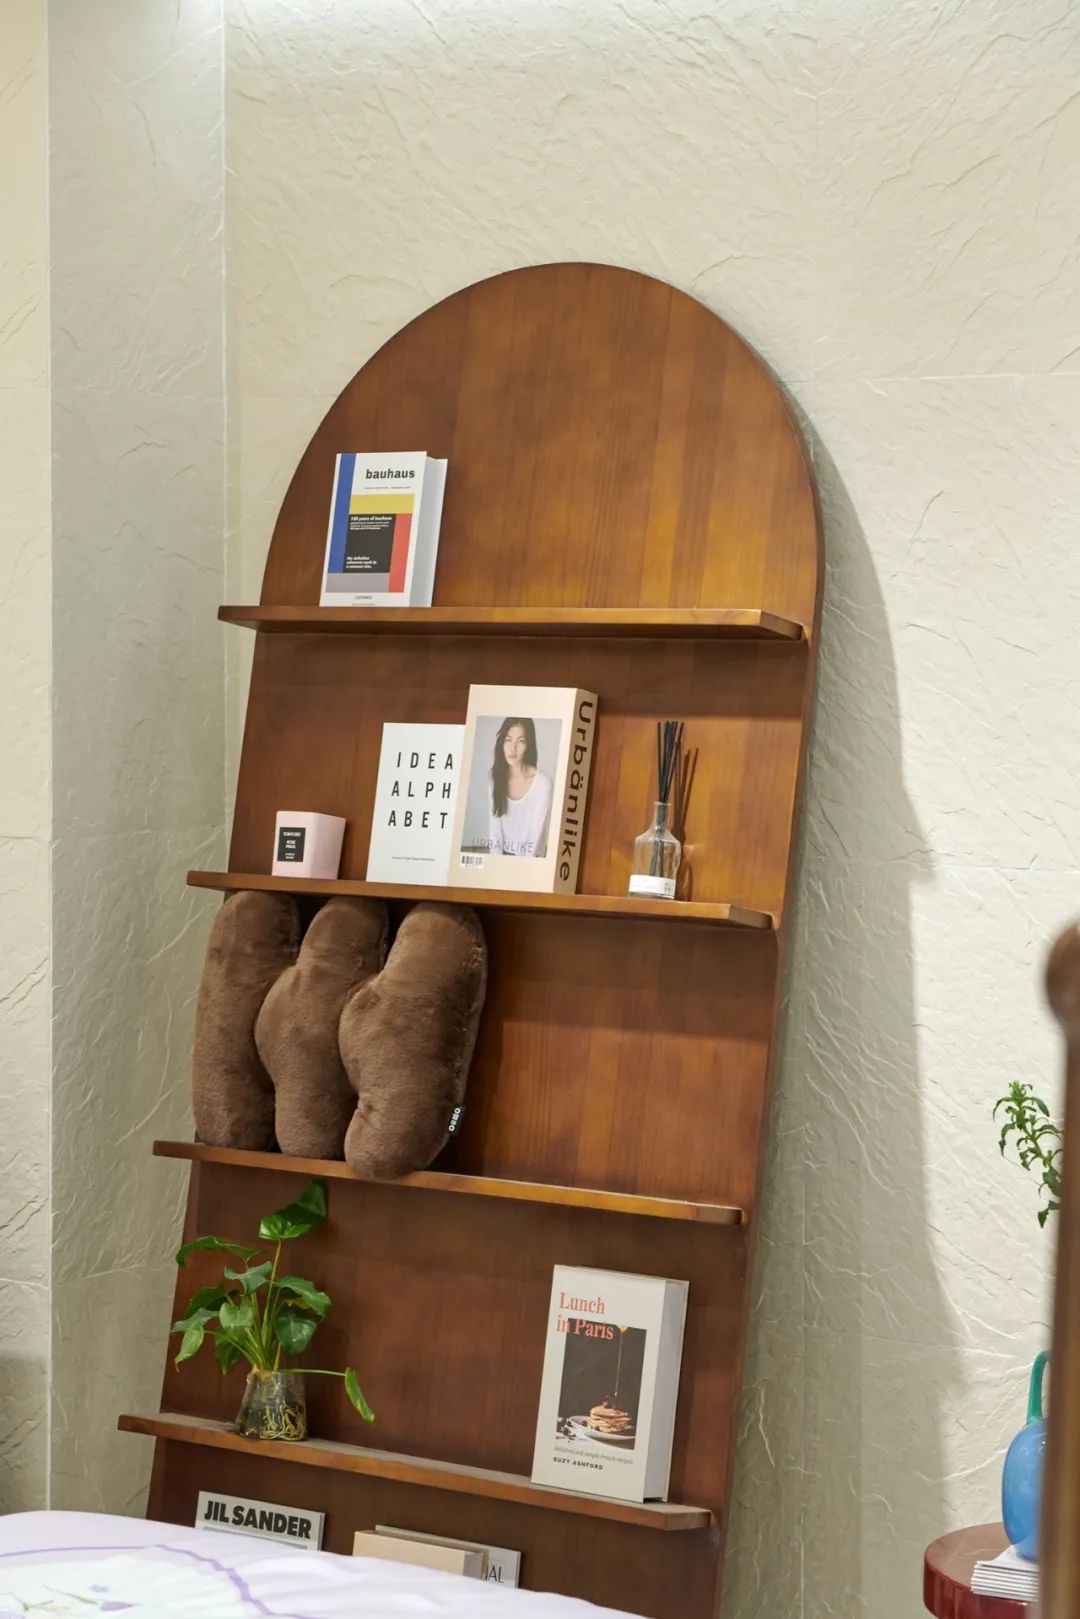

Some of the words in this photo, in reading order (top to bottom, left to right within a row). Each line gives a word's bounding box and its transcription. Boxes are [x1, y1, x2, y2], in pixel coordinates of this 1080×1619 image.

[365, 468, 415, 479] bauhaus
[396, 751, 453, 770] IDEA
[391, 780, 452, 799] ALPH
[388, 810, 448, 829] ABET
[472, 837, 534, 853] URBANLIKE
[560, 1291, 605, 1314] Lunch
[557, 1314, 570, 1333] in
[574, 1318, 614, 1340] Paris
[572, 1460, 604, 1470] ASHFORD
[204, 1500, 229, 1523] JIL
[231, 1505, 312, 1539] SANDER
